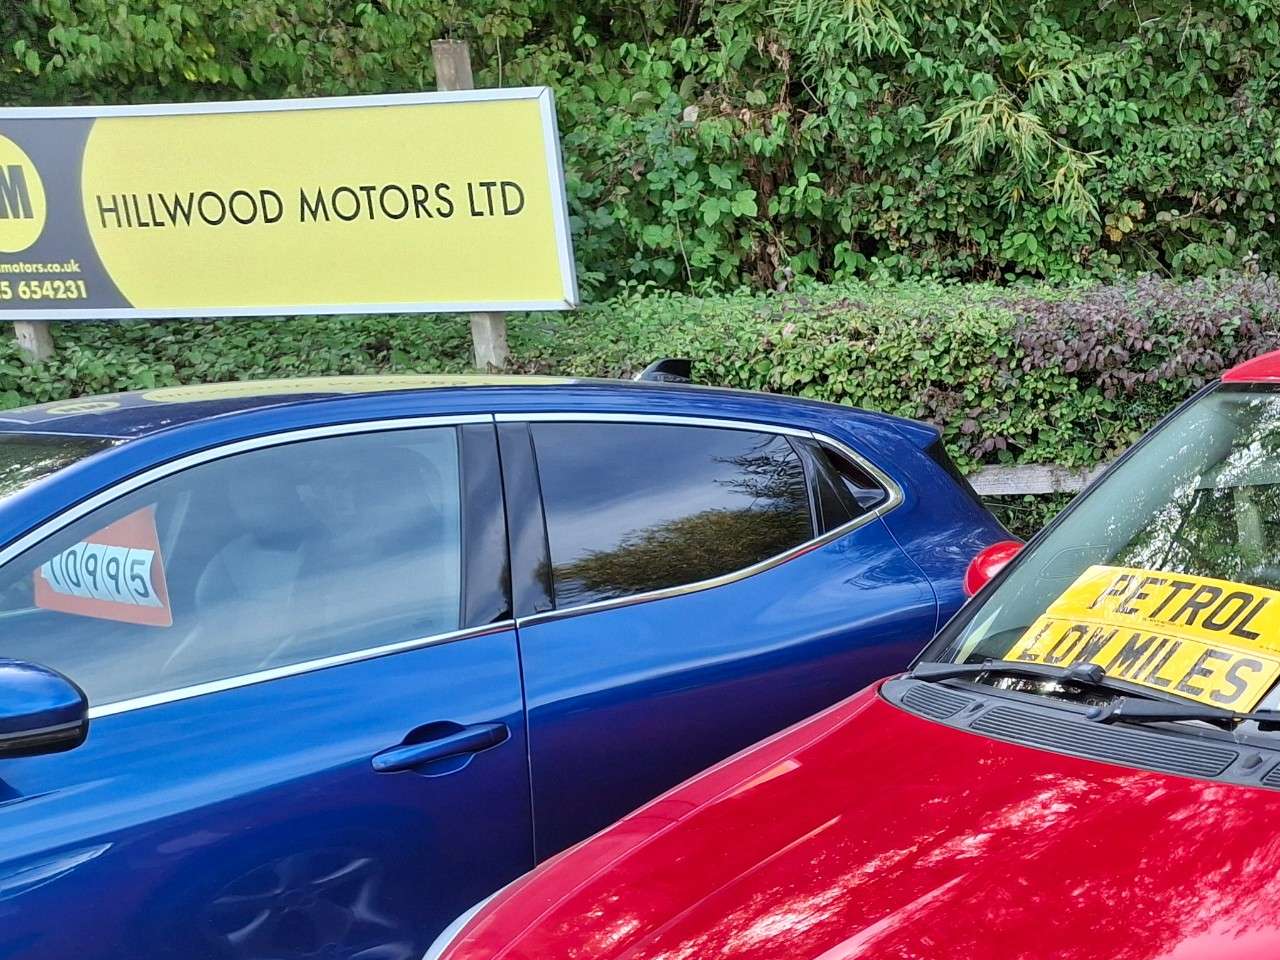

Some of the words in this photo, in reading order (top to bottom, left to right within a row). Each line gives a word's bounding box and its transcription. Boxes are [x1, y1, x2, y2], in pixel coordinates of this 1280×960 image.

[96, 190, 283, 228] HILLWOOD
[300, 183, 454, 223] MOTORS
[467, 181, 525, 217] LTD
[18, 280, 87, 299] 654231
[50, 549, 150, 598] 10995
[1086, 574, 1271, 641] PETROL
[1018, 621, 1119, 664] LOW
[1104, 632, 1264, 704] MILES
